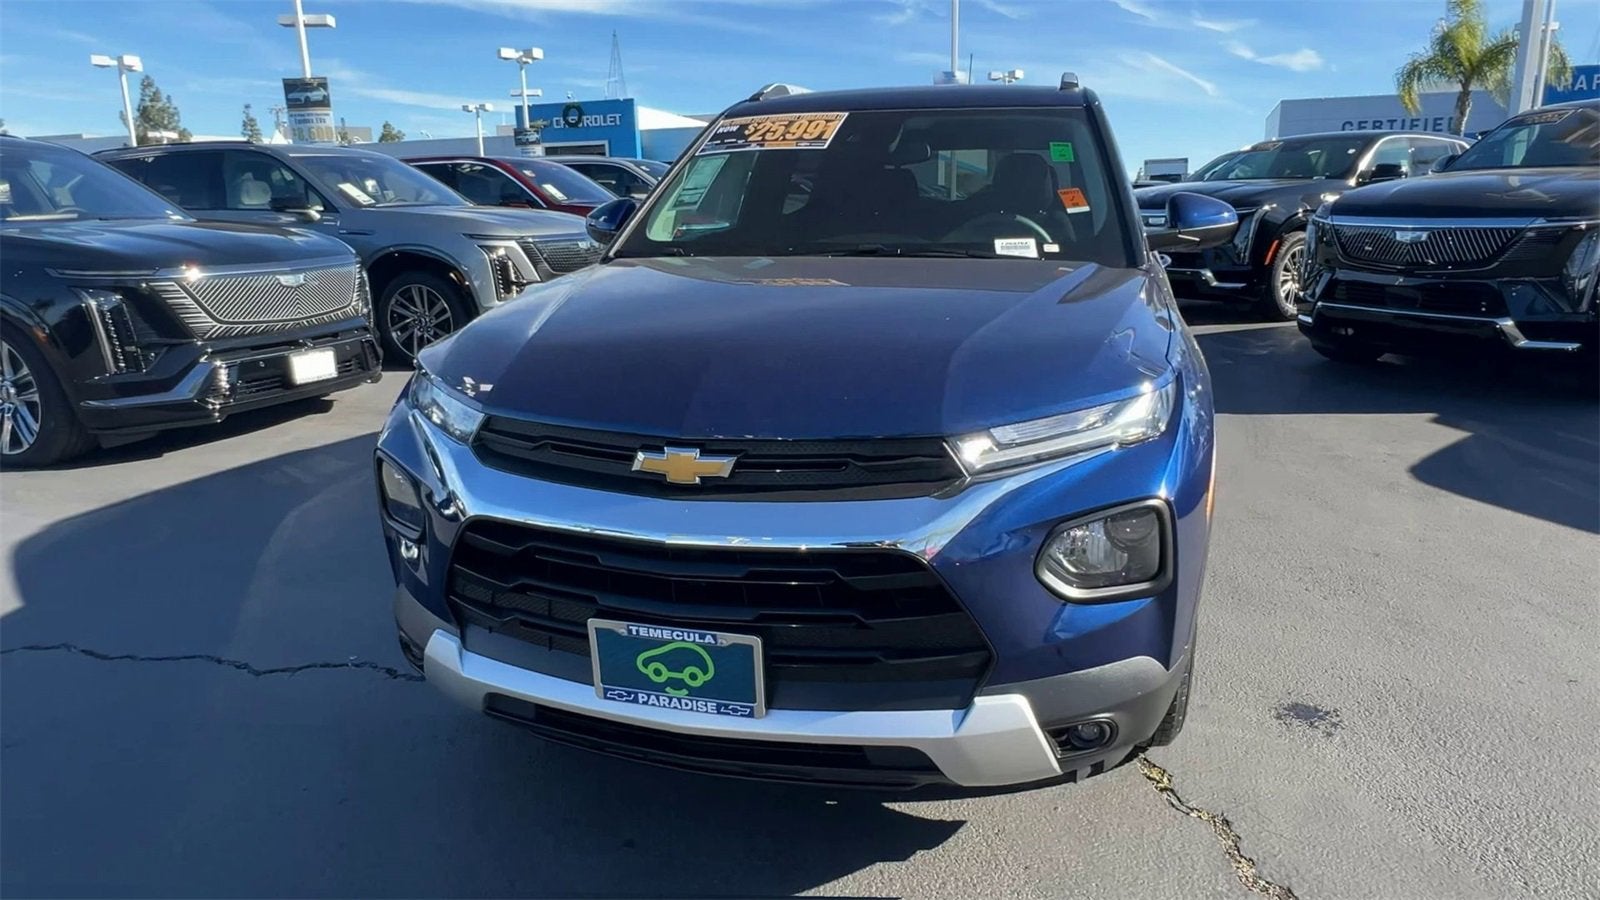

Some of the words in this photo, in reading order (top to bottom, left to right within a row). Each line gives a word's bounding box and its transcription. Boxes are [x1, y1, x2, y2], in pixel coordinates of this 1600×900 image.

[717, 125, 740, 134] NOW
[744, 119, 840, 141] $25,991
[629, 626, 716, 644] TEMECULA
[637, 693, 718, 713] PARADISE
